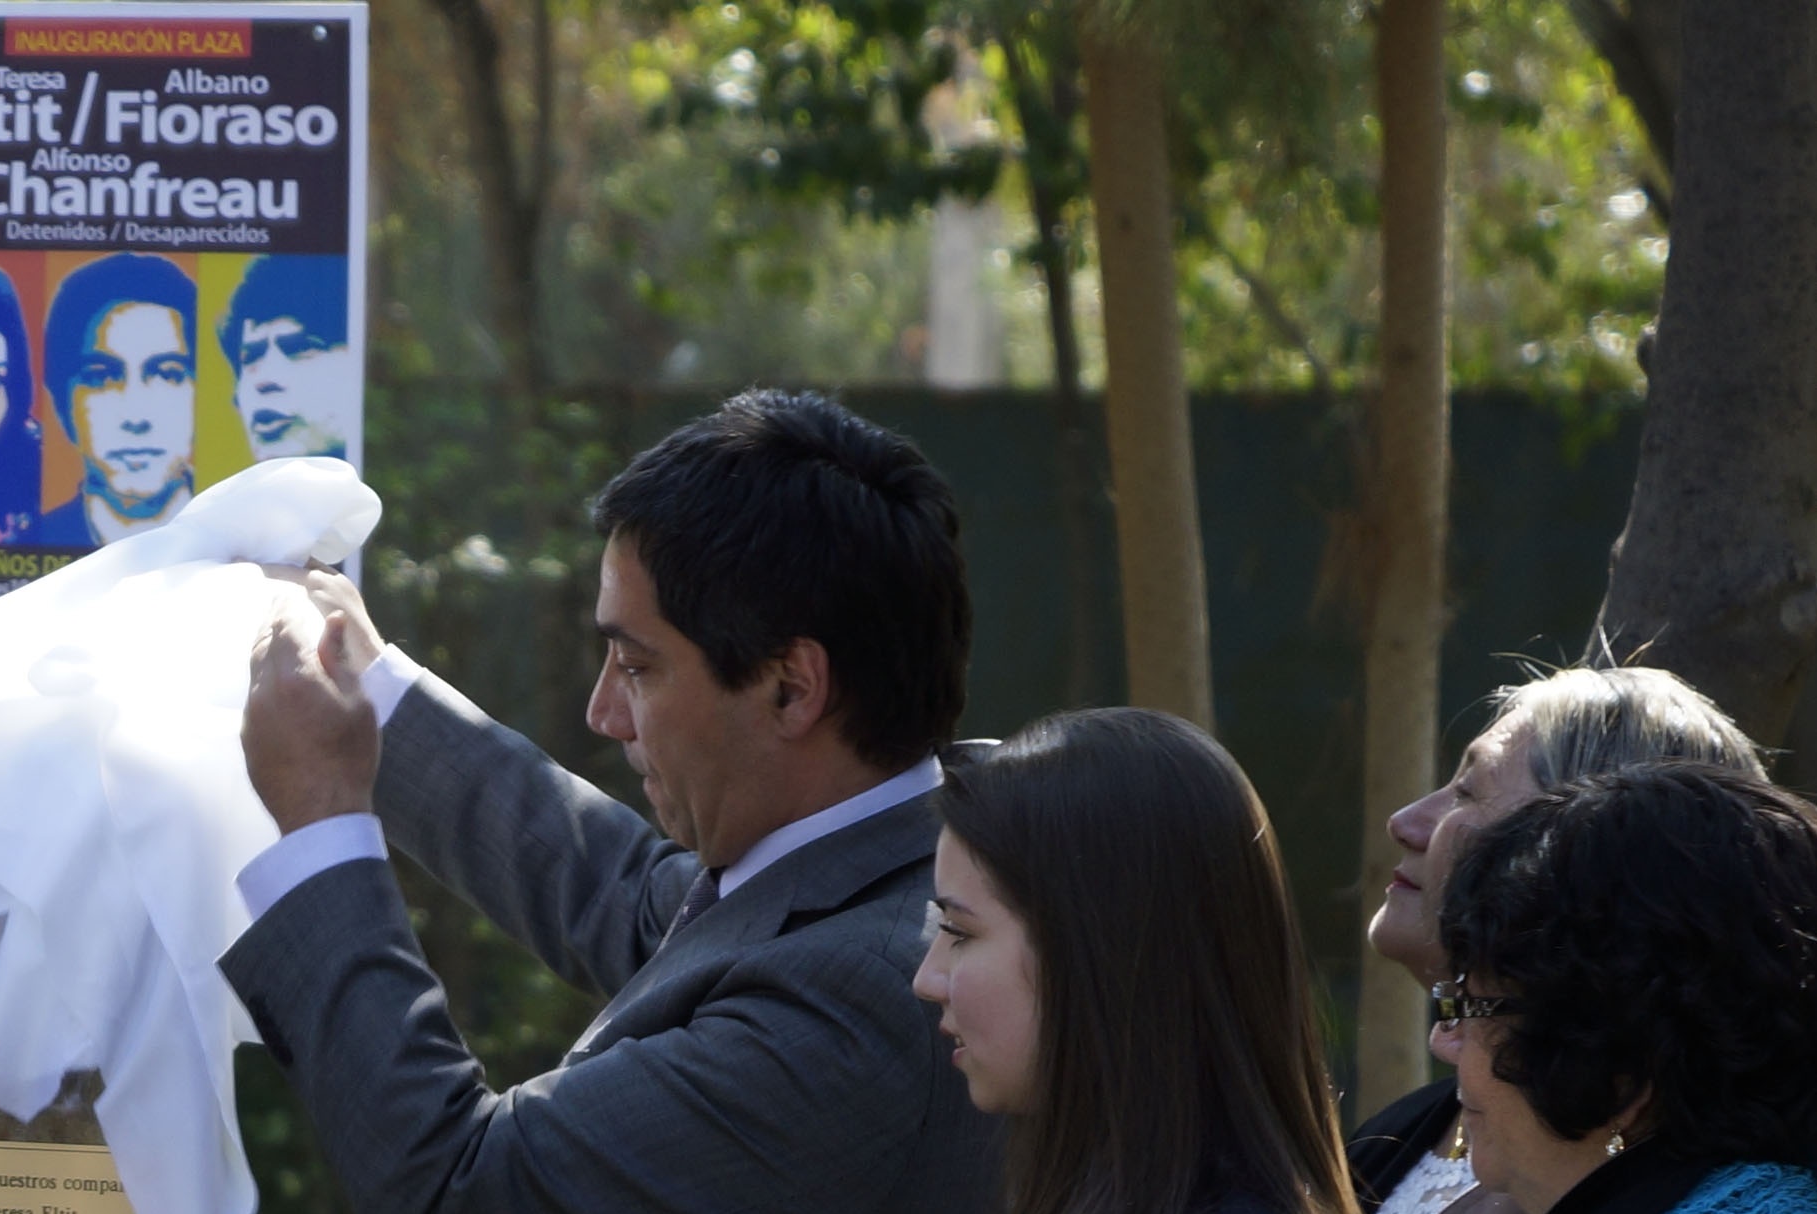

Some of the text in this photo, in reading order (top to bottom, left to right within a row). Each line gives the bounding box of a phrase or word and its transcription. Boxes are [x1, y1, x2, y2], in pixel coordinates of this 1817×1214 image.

[14, 28, 243, 54] INAUGURACIÓN PLAZA
[165, 69, 269, 94] Albano
[106, 91, 338, 145] Fioraso
[32, 148, 131, 172] Alfonso
[7, 221, 269, 245] Detenidos / Desaparecidos
